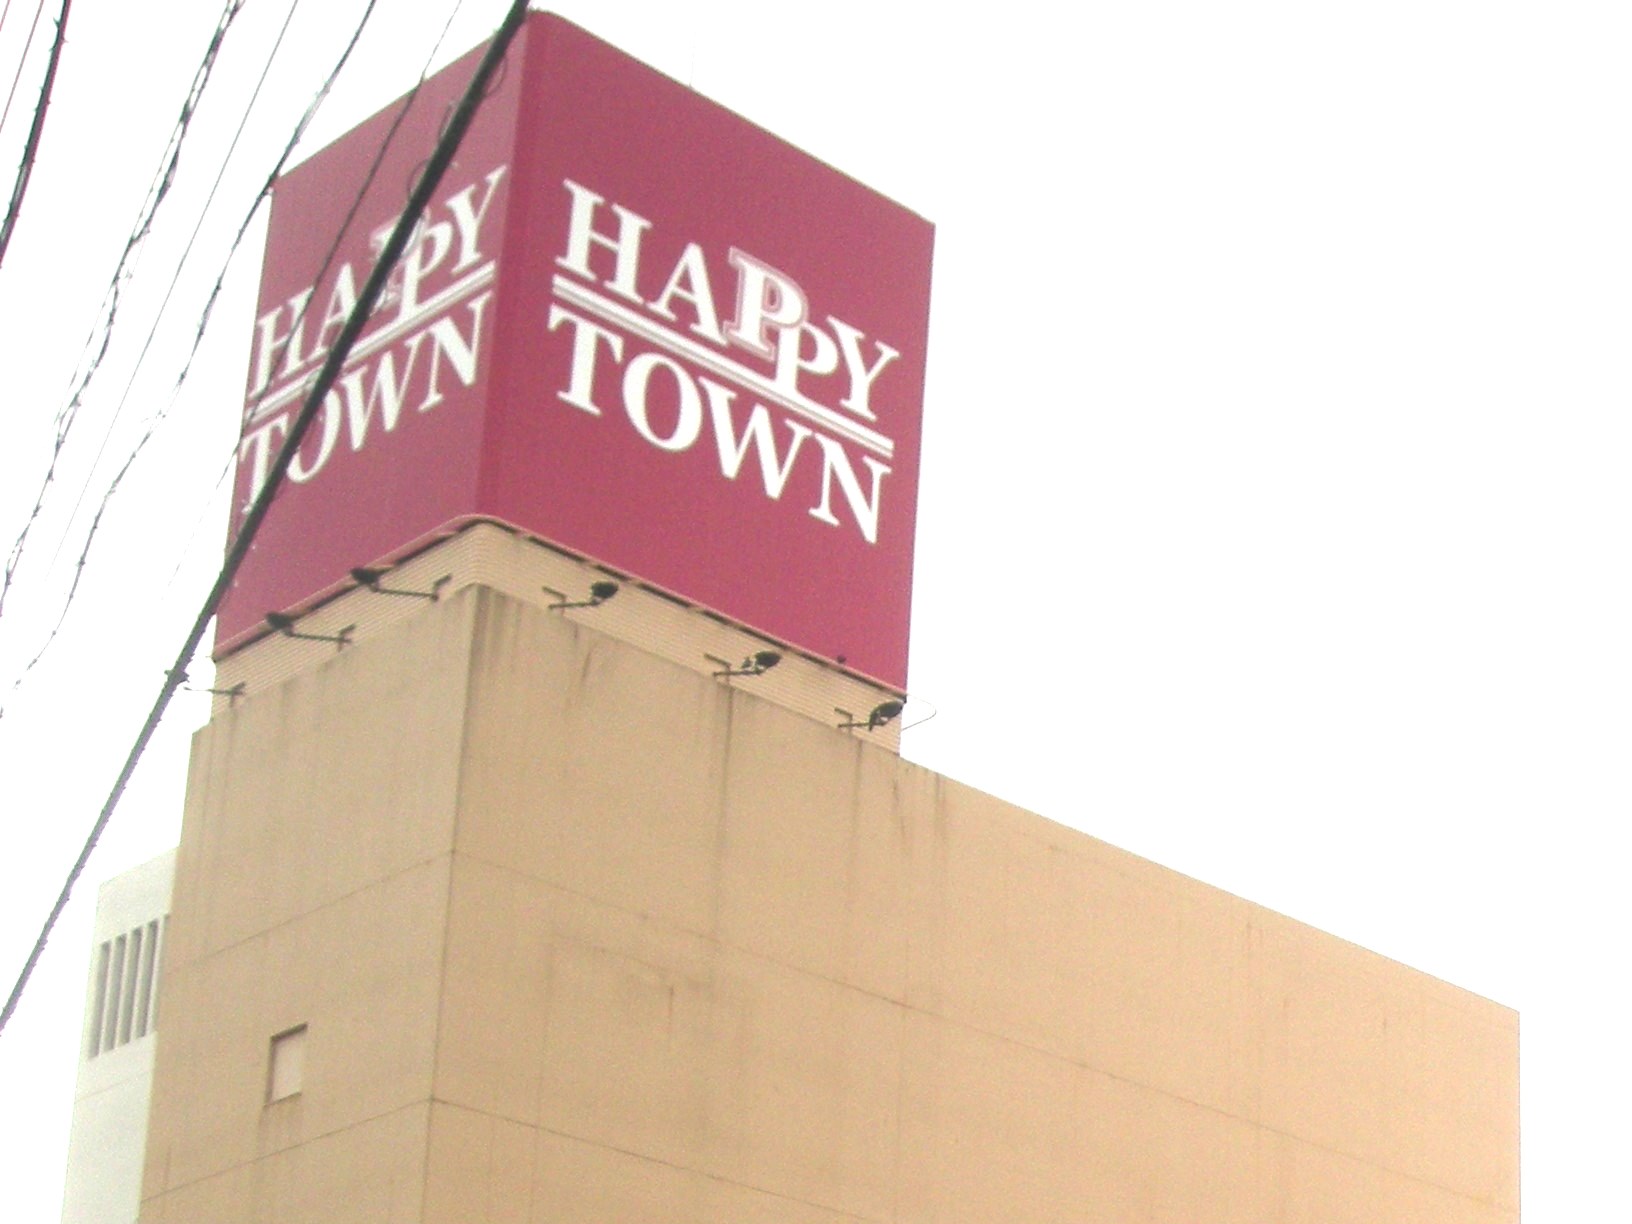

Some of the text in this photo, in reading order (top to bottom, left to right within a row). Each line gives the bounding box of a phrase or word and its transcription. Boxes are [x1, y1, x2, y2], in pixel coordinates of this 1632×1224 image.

[239, 290, 493, 515] TOWN
[555, 179, 899, 420] HAPPY
[547, 302, 891, 544] TOWN
